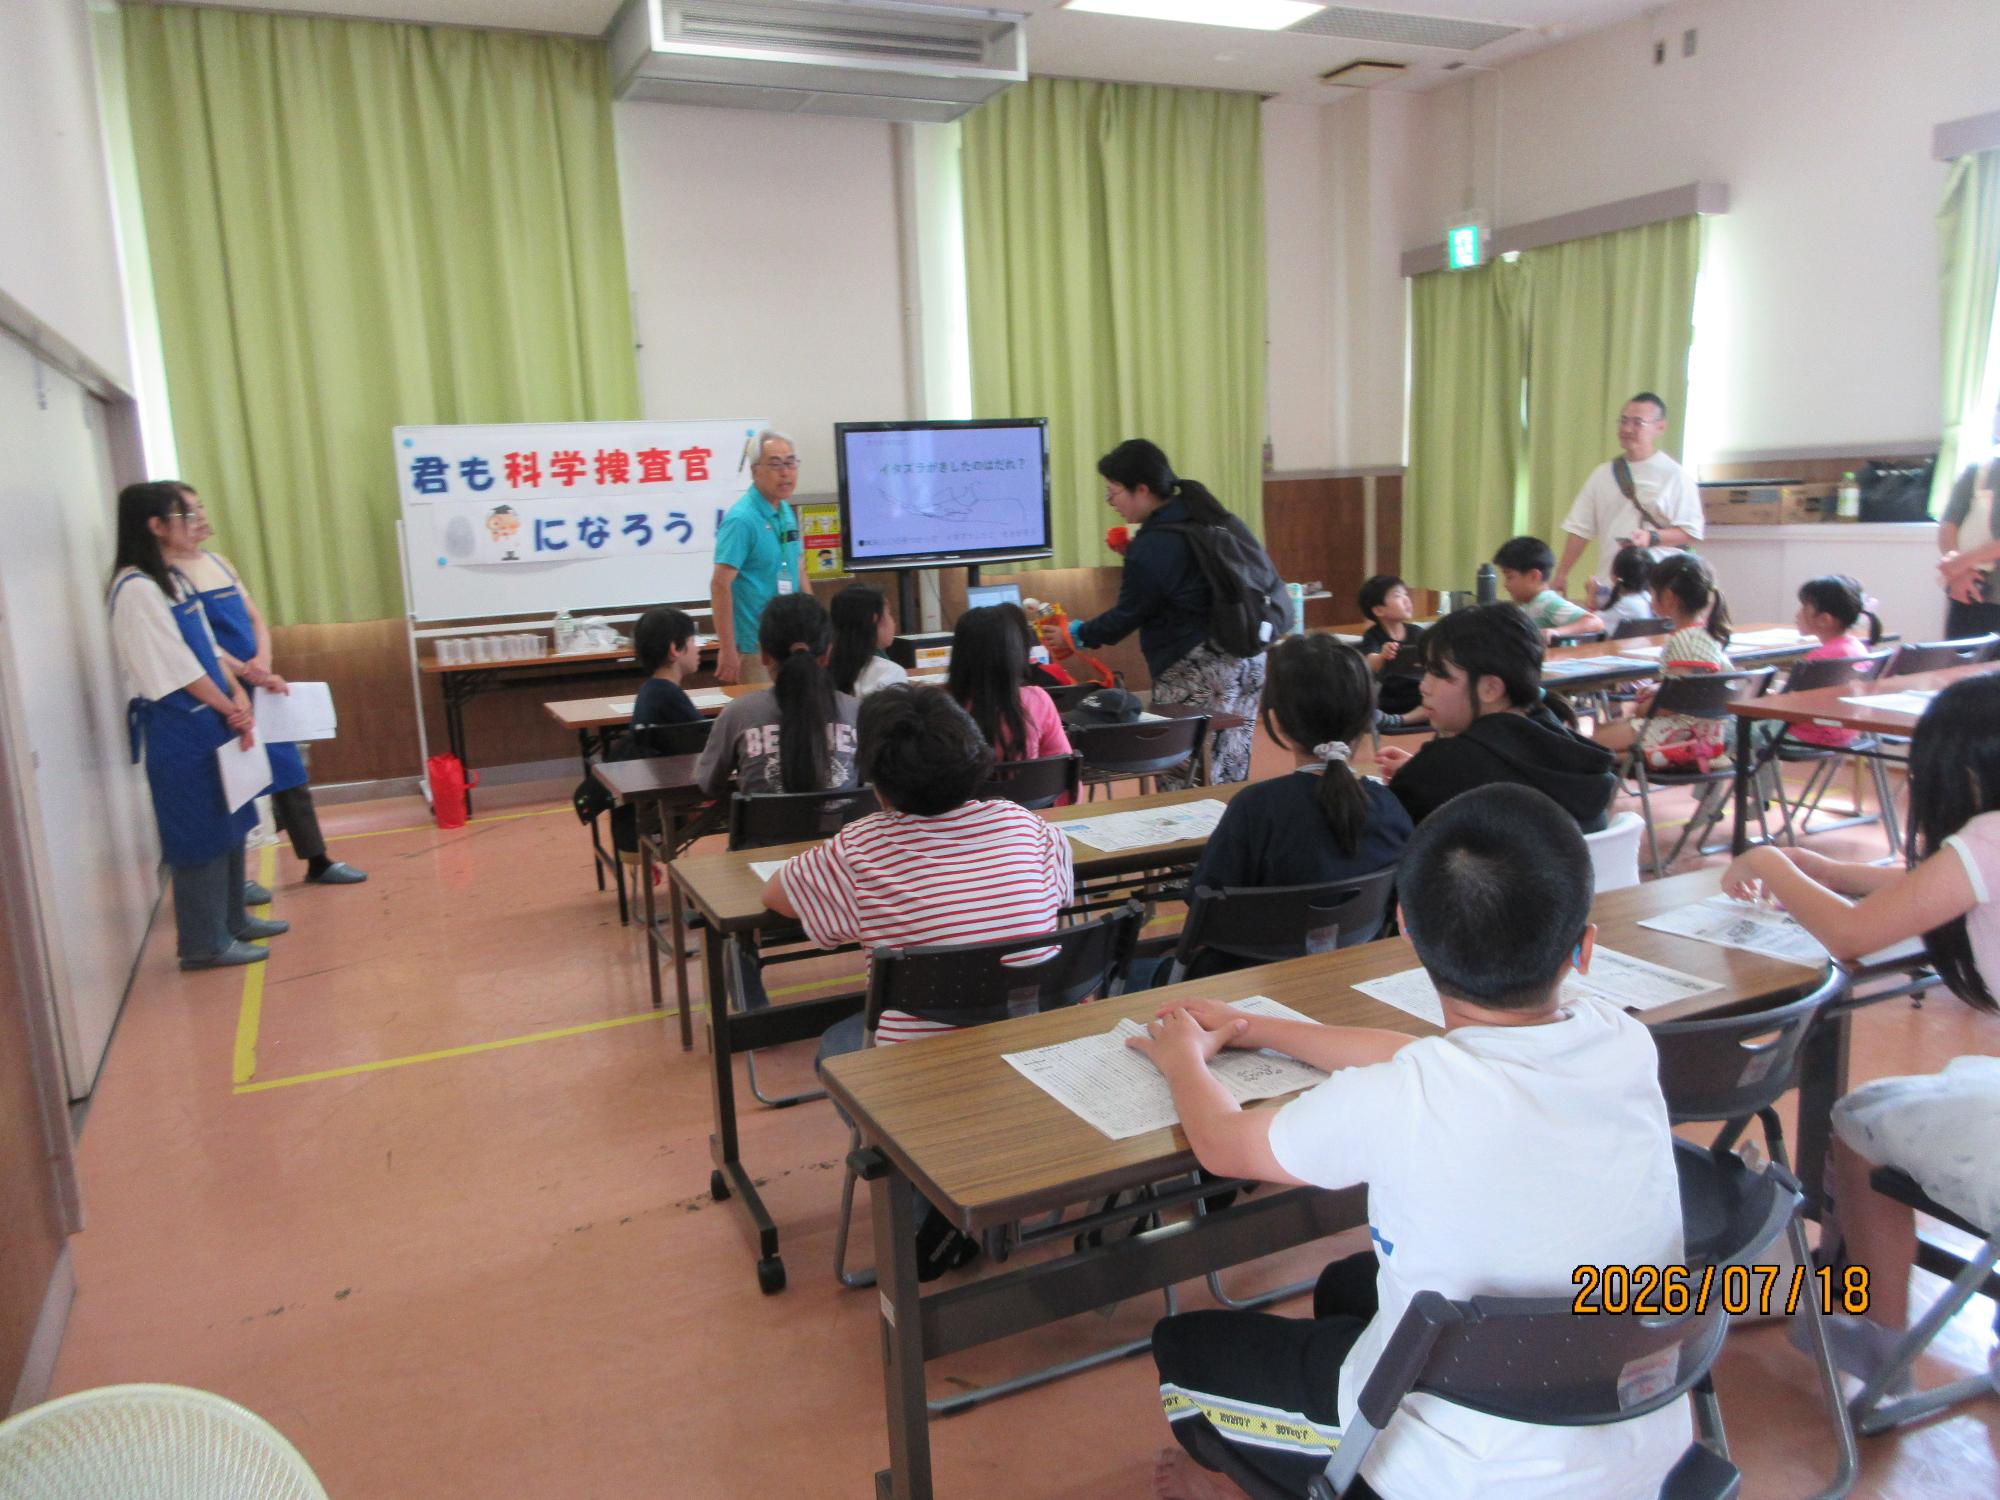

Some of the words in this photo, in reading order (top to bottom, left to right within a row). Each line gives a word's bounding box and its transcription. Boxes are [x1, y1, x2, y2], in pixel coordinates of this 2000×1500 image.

[411, 446, 713, 495] 君も科学捜査官
